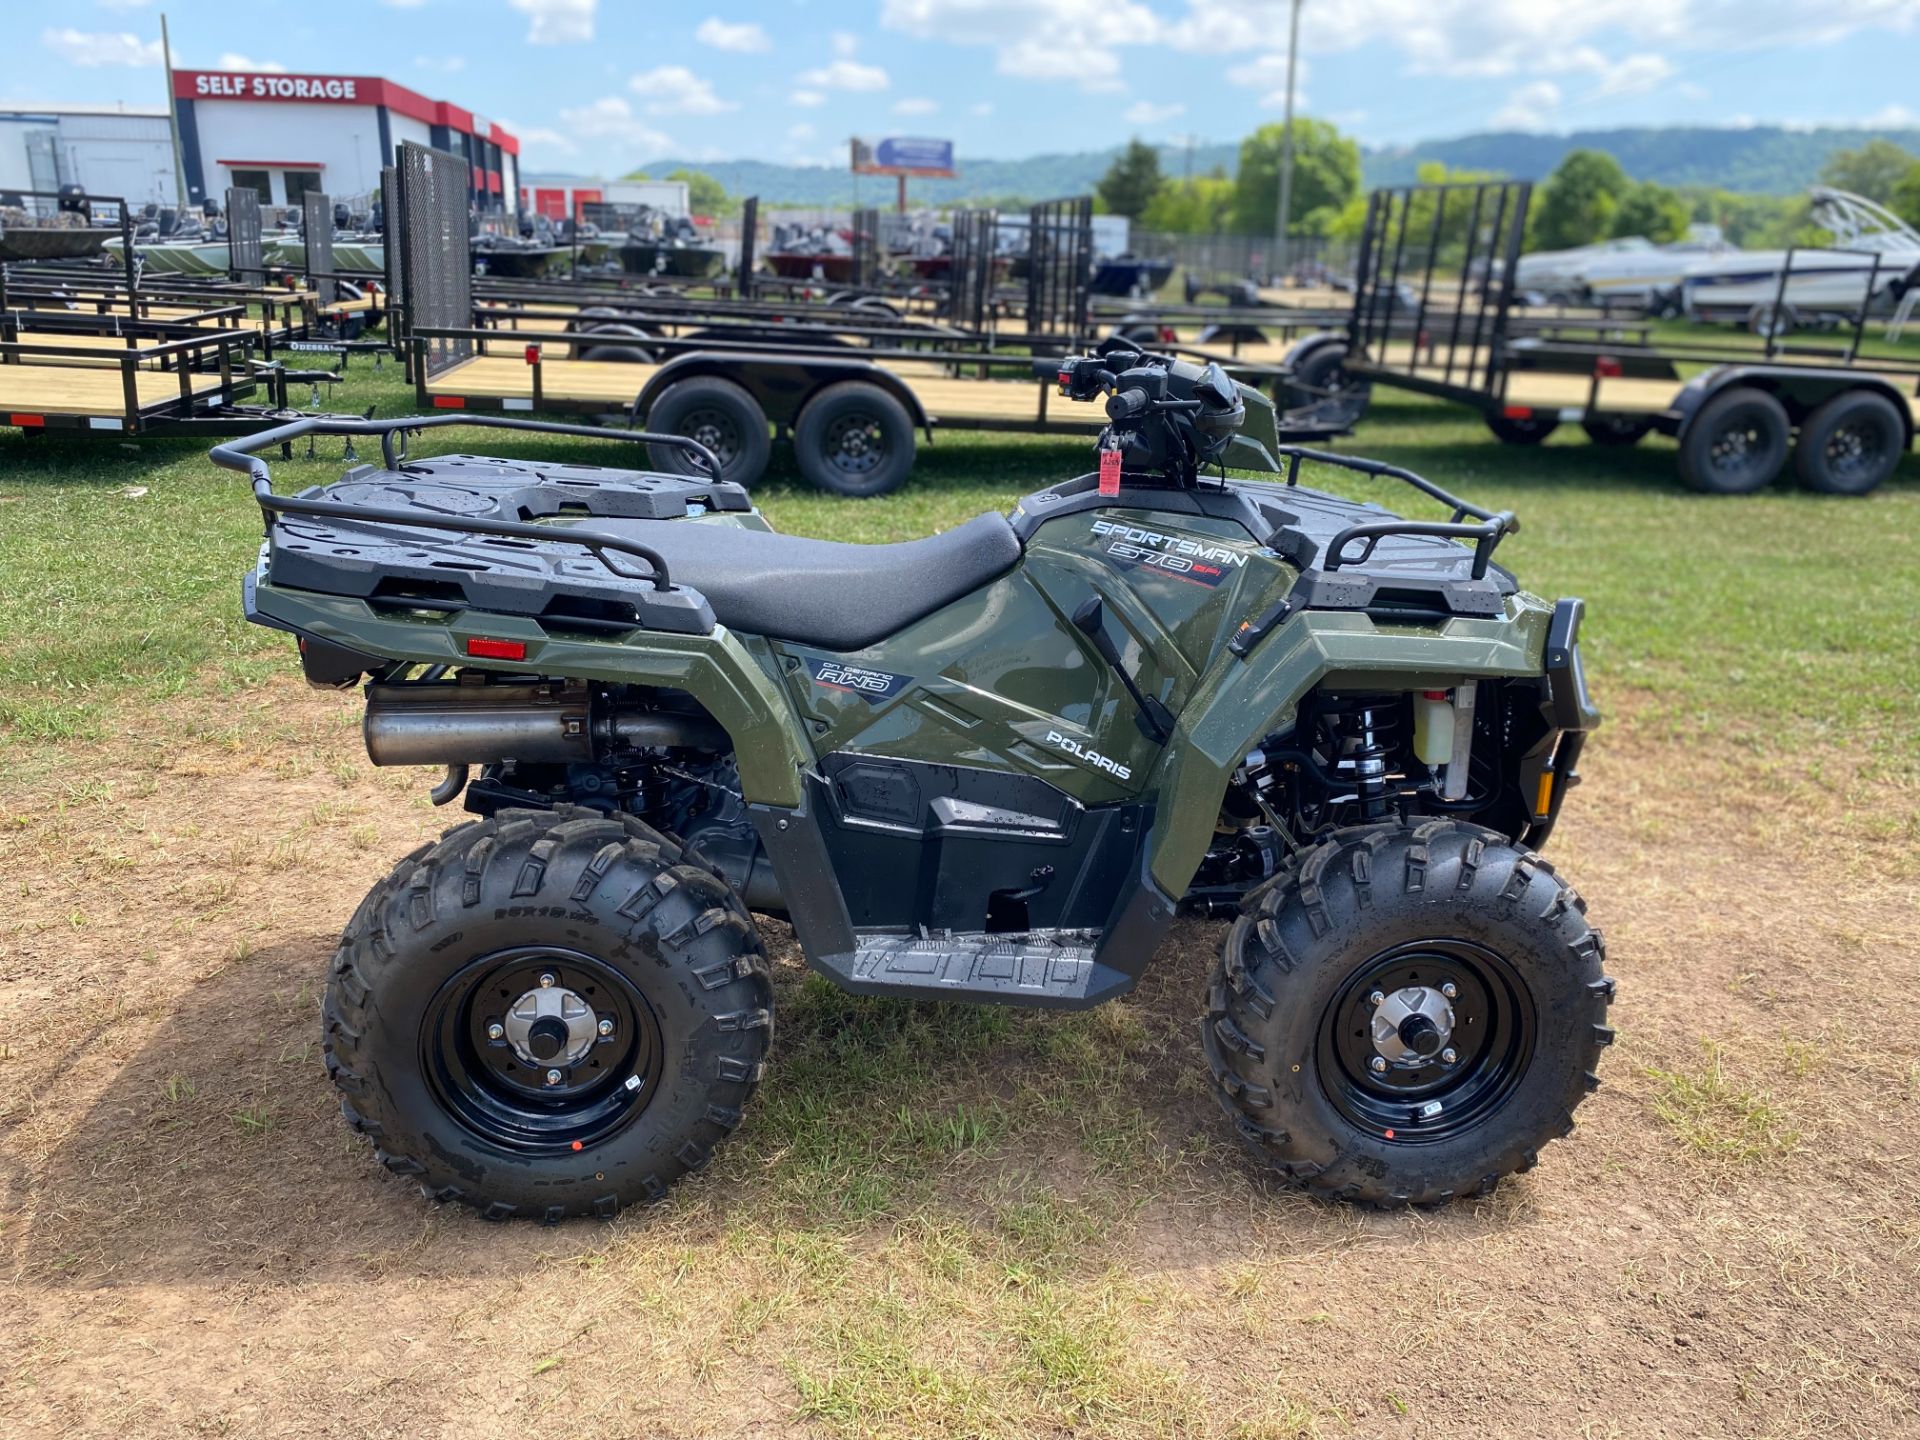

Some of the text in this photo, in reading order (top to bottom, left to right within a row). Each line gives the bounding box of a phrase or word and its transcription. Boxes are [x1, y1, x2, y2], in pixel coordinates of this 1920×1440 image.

[196, 75, 356, 99] SELF STORAGE
[1091, 520, 1249, 568] SPORTSMAN
[1107, 541, 1194, 573] 570
[816, 668, 890, 692] AWD
[843, 665, 894, 681] DEMAND
[1046, 730, 1132, 780] POLARIS
